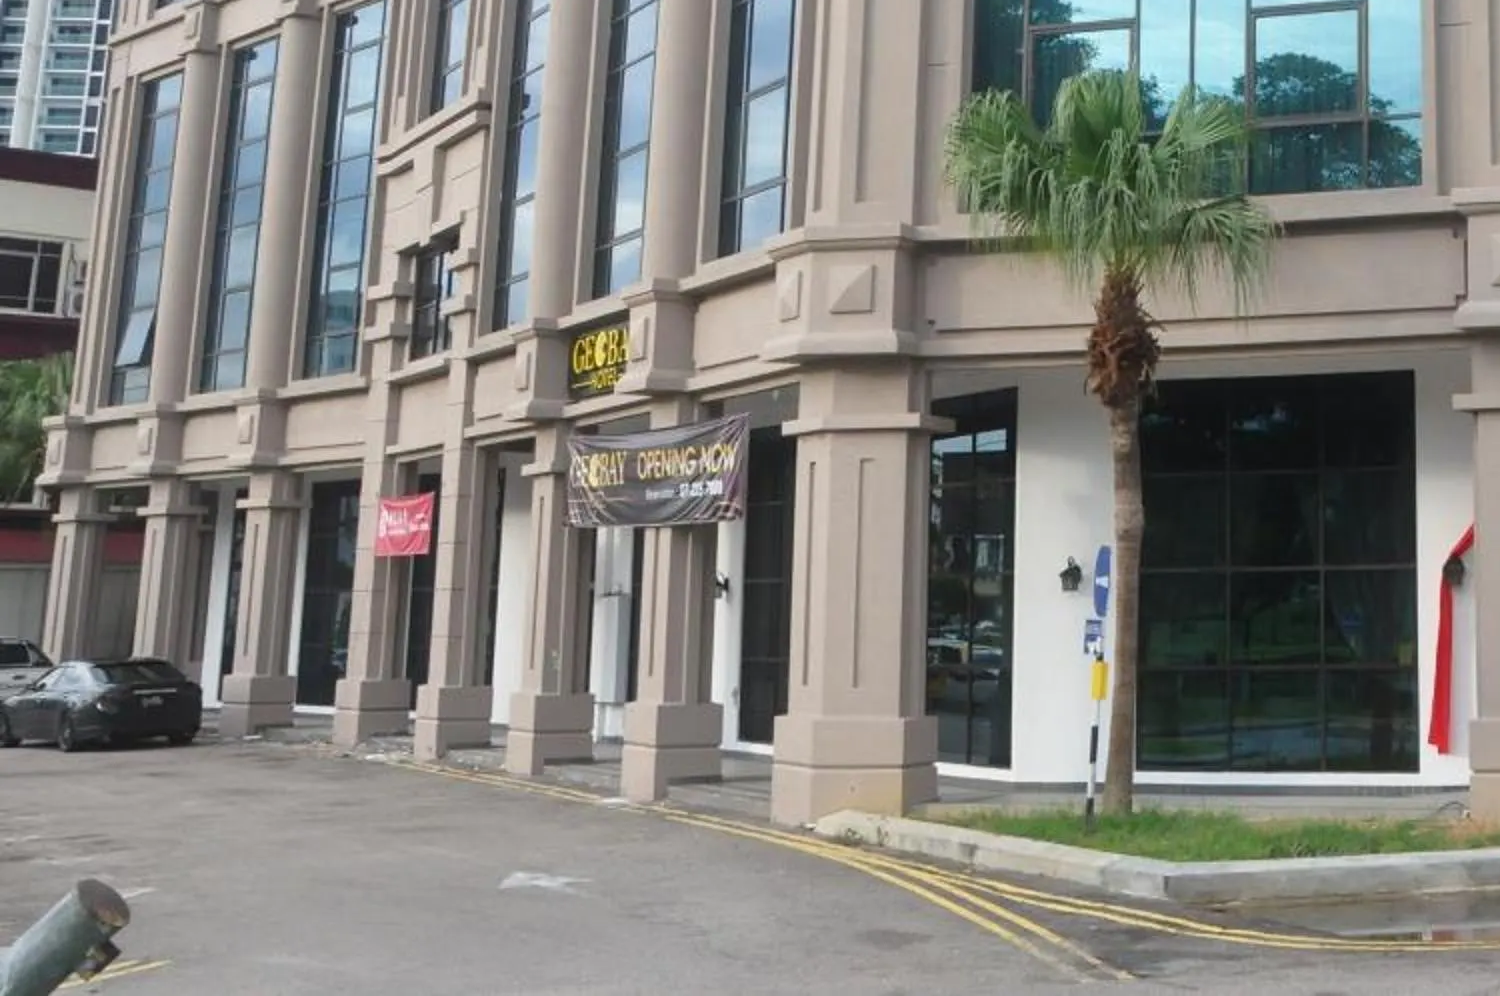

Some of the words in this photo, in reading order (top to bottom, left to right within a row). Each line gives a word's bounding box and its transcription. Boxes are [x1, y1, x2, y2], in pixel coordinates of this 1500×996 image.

[573, 326, 630, 375] GEOBA
[636, 445, 697, 480] OPENING
[699, 442, 737, 473] NOW
